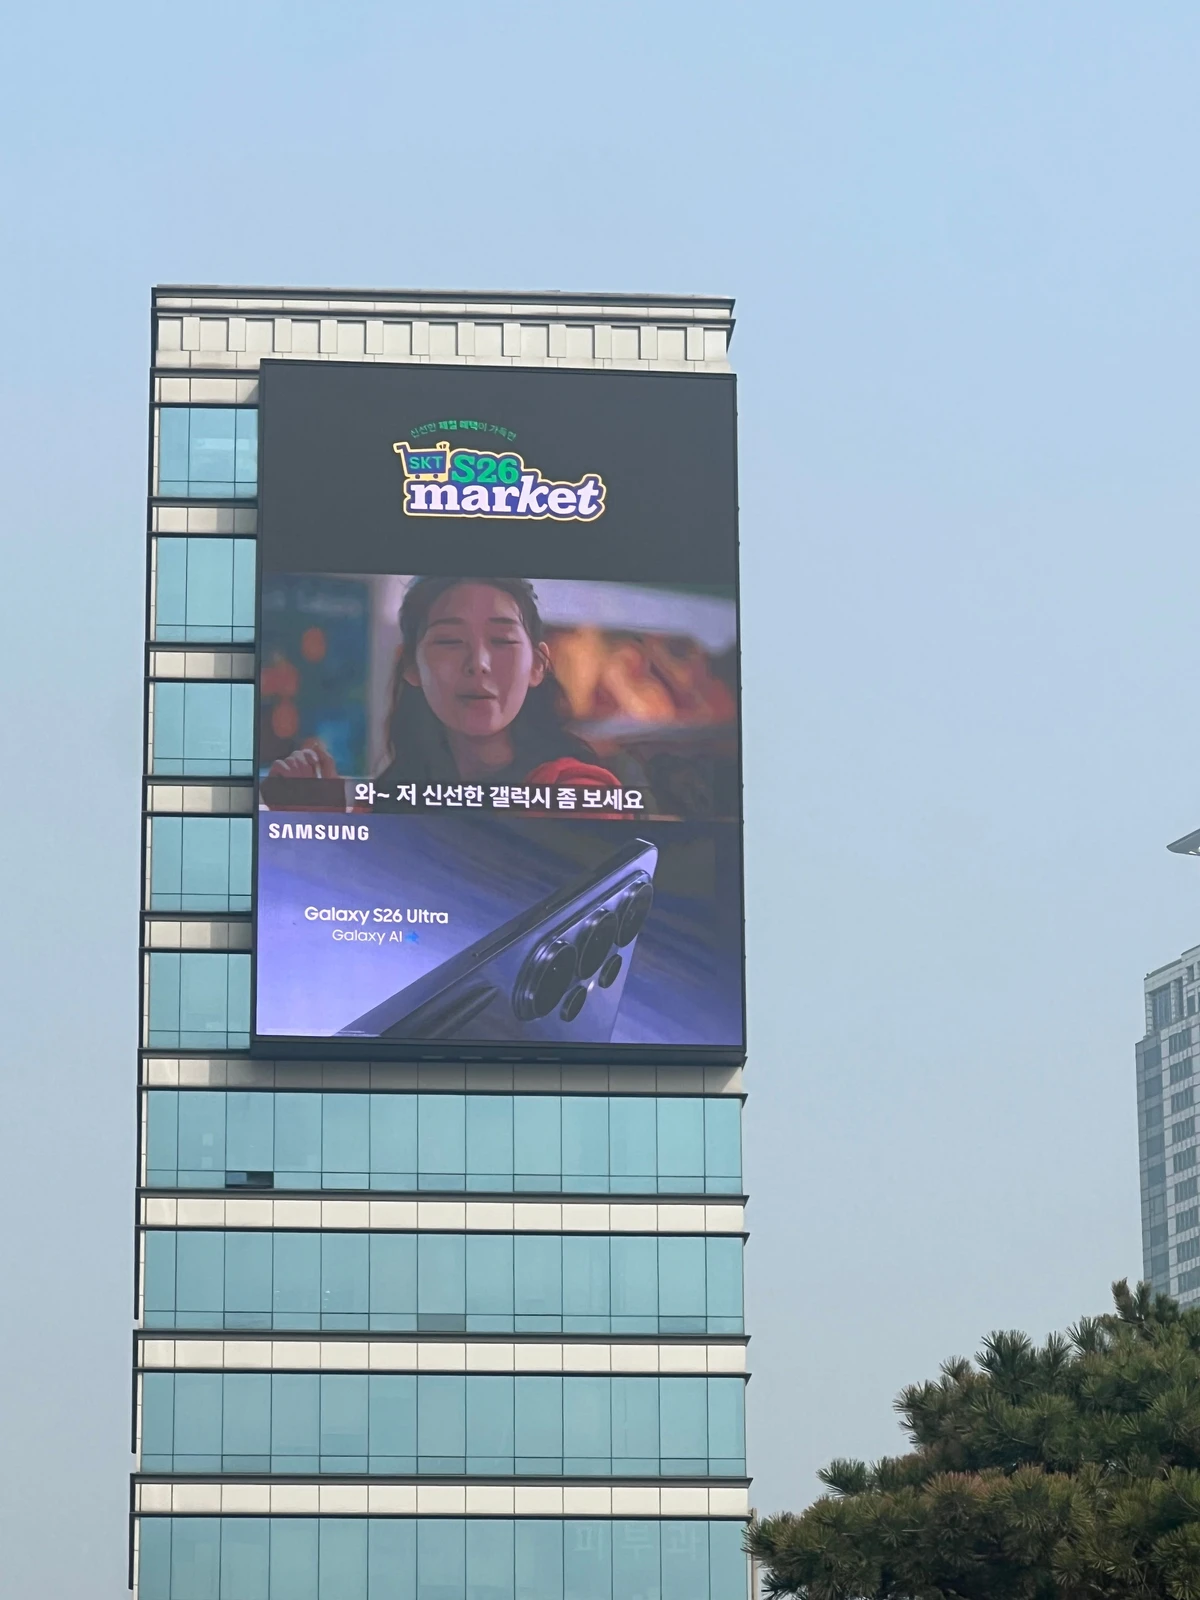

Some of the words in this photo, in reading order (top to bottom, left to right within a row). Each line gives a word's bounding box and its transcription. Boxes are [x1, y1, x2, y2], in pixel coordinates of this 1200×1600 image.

[408, 455, 443, 470] SKT
[451, 454, 519, 484] S26
[410, 475, 599, 516] market
[354, 782, 390, 805] 와~
[396, 783, 417, 806] 저
[422, 784, 485, 807] 신선한
[489, 785, 550, 809] 갤럭시
[556, 787, 578, 810] 좀
[582, 788, 645, 811] 보세요
[268, 823, 370, 842] SAMSUNG
[304, 906, 370, 926] Galaxy
[373, 908, 403, 923] S26
[406, 908, 449, 924] Ultra
[332, 929, 386, 946] Galaxy
[388, 930, 403, 943] AI
[572, 1524, 701, 1561] 피부과
